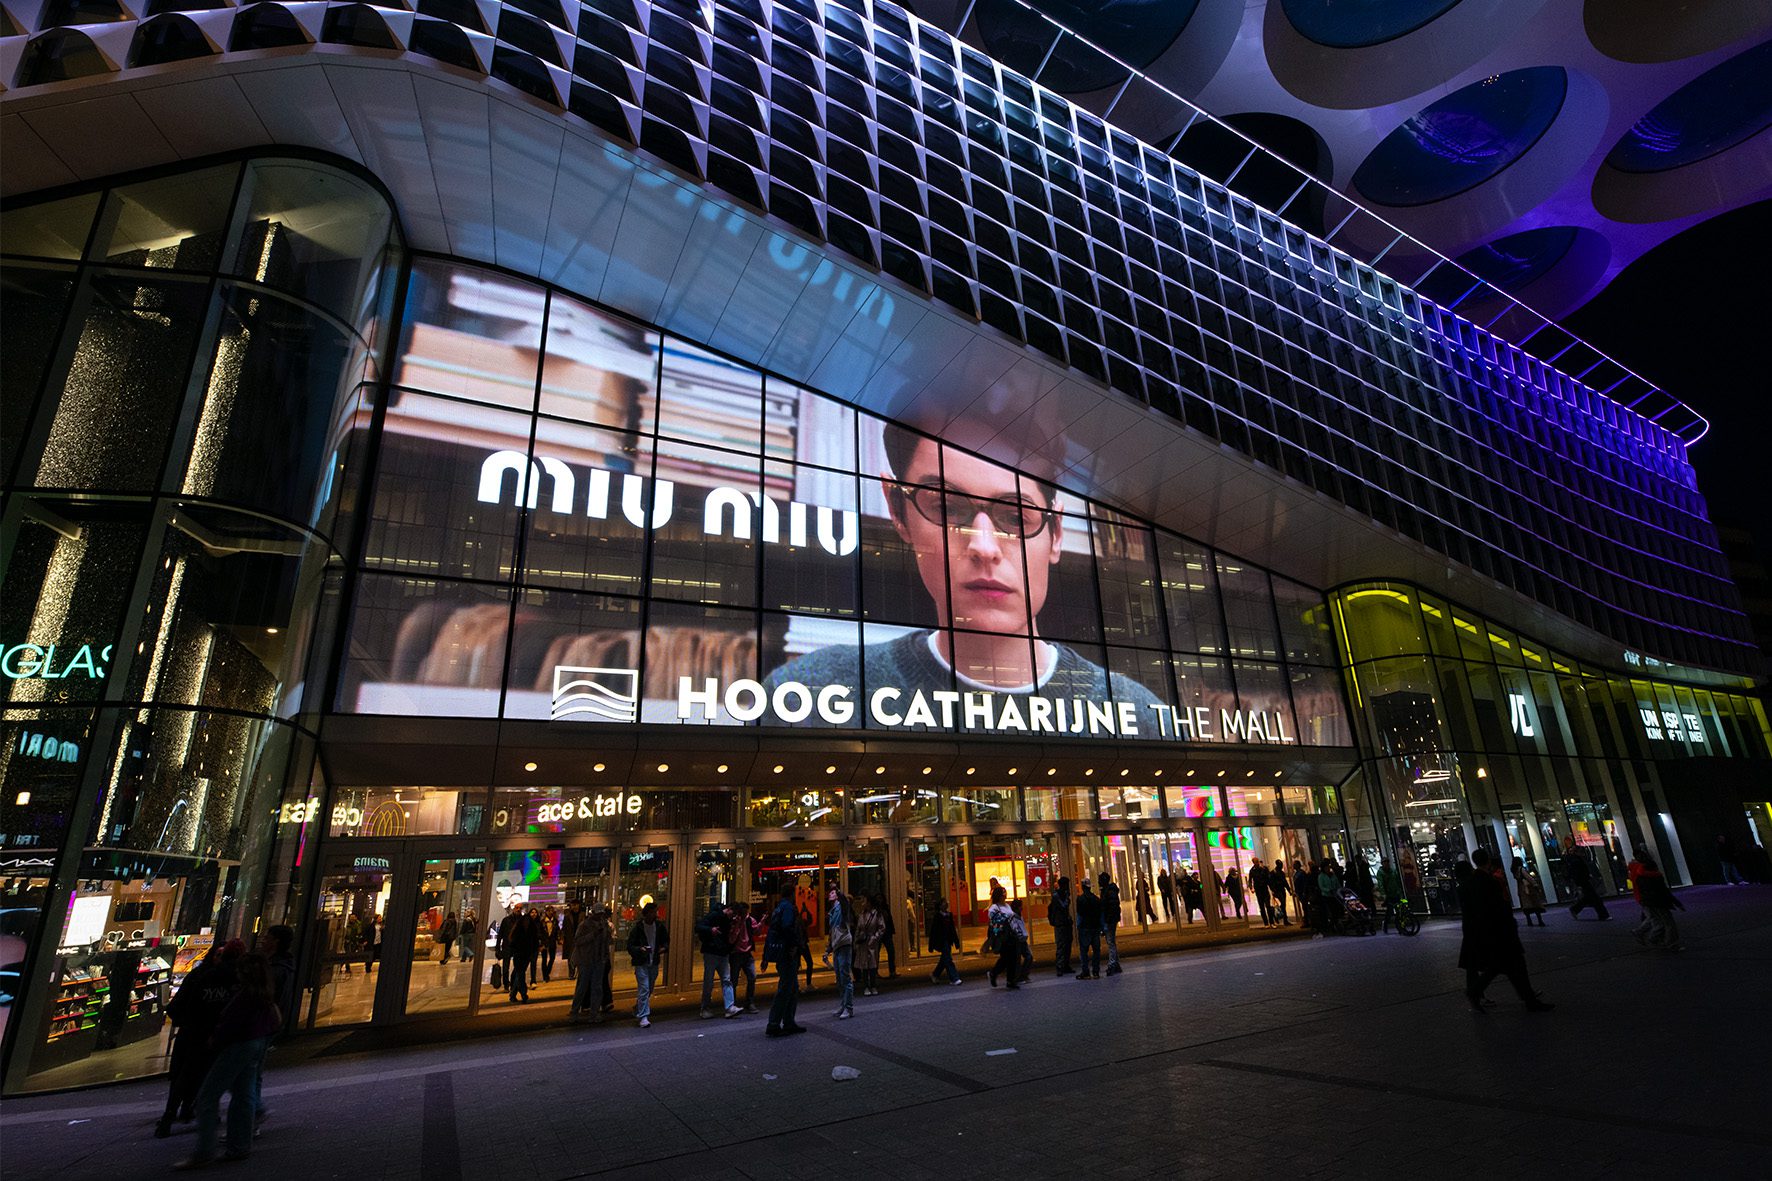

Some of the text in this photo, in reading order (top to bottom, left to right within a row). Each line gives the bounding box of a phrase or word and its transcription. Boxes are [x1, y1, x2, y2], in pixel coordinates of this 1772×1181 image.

[0, 644, 112, 679] GLAS
[678, 676, 1294, 742] HOOG CATHARIJNE THE MALL
[537, 801, 574, 823] ace
[577, 797, 593, 819] &
